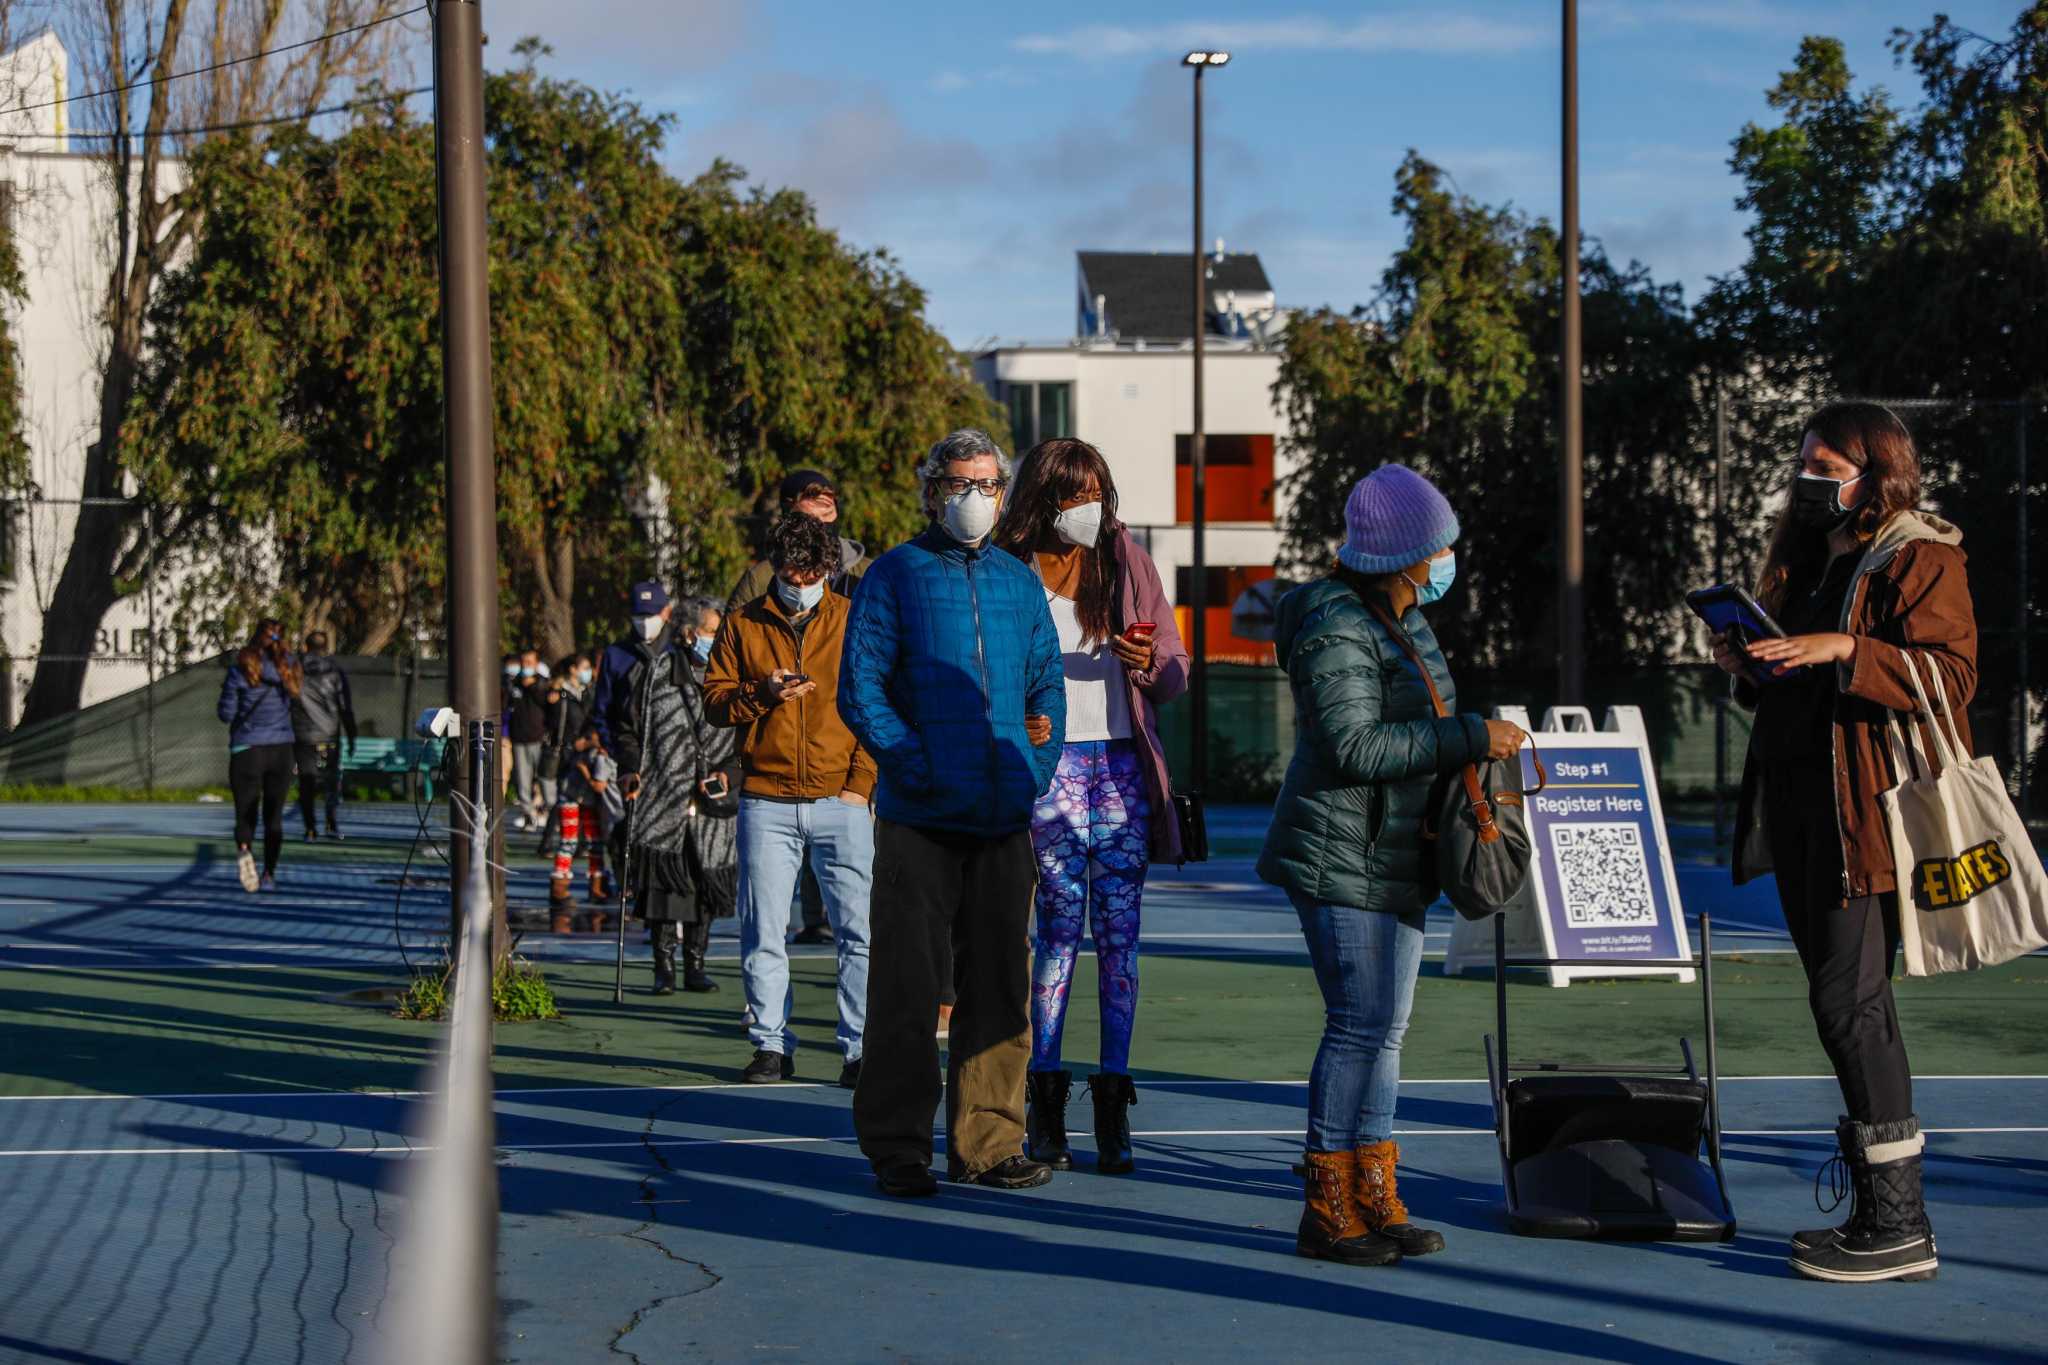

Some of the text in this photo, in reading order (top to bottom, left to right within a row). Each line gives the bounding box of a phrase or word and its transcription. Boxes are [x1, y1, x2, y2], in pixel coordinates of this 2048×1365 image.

[1555, 762, 1609, 779] Step #1
[1535, 796, 1643, 816] Register Here
